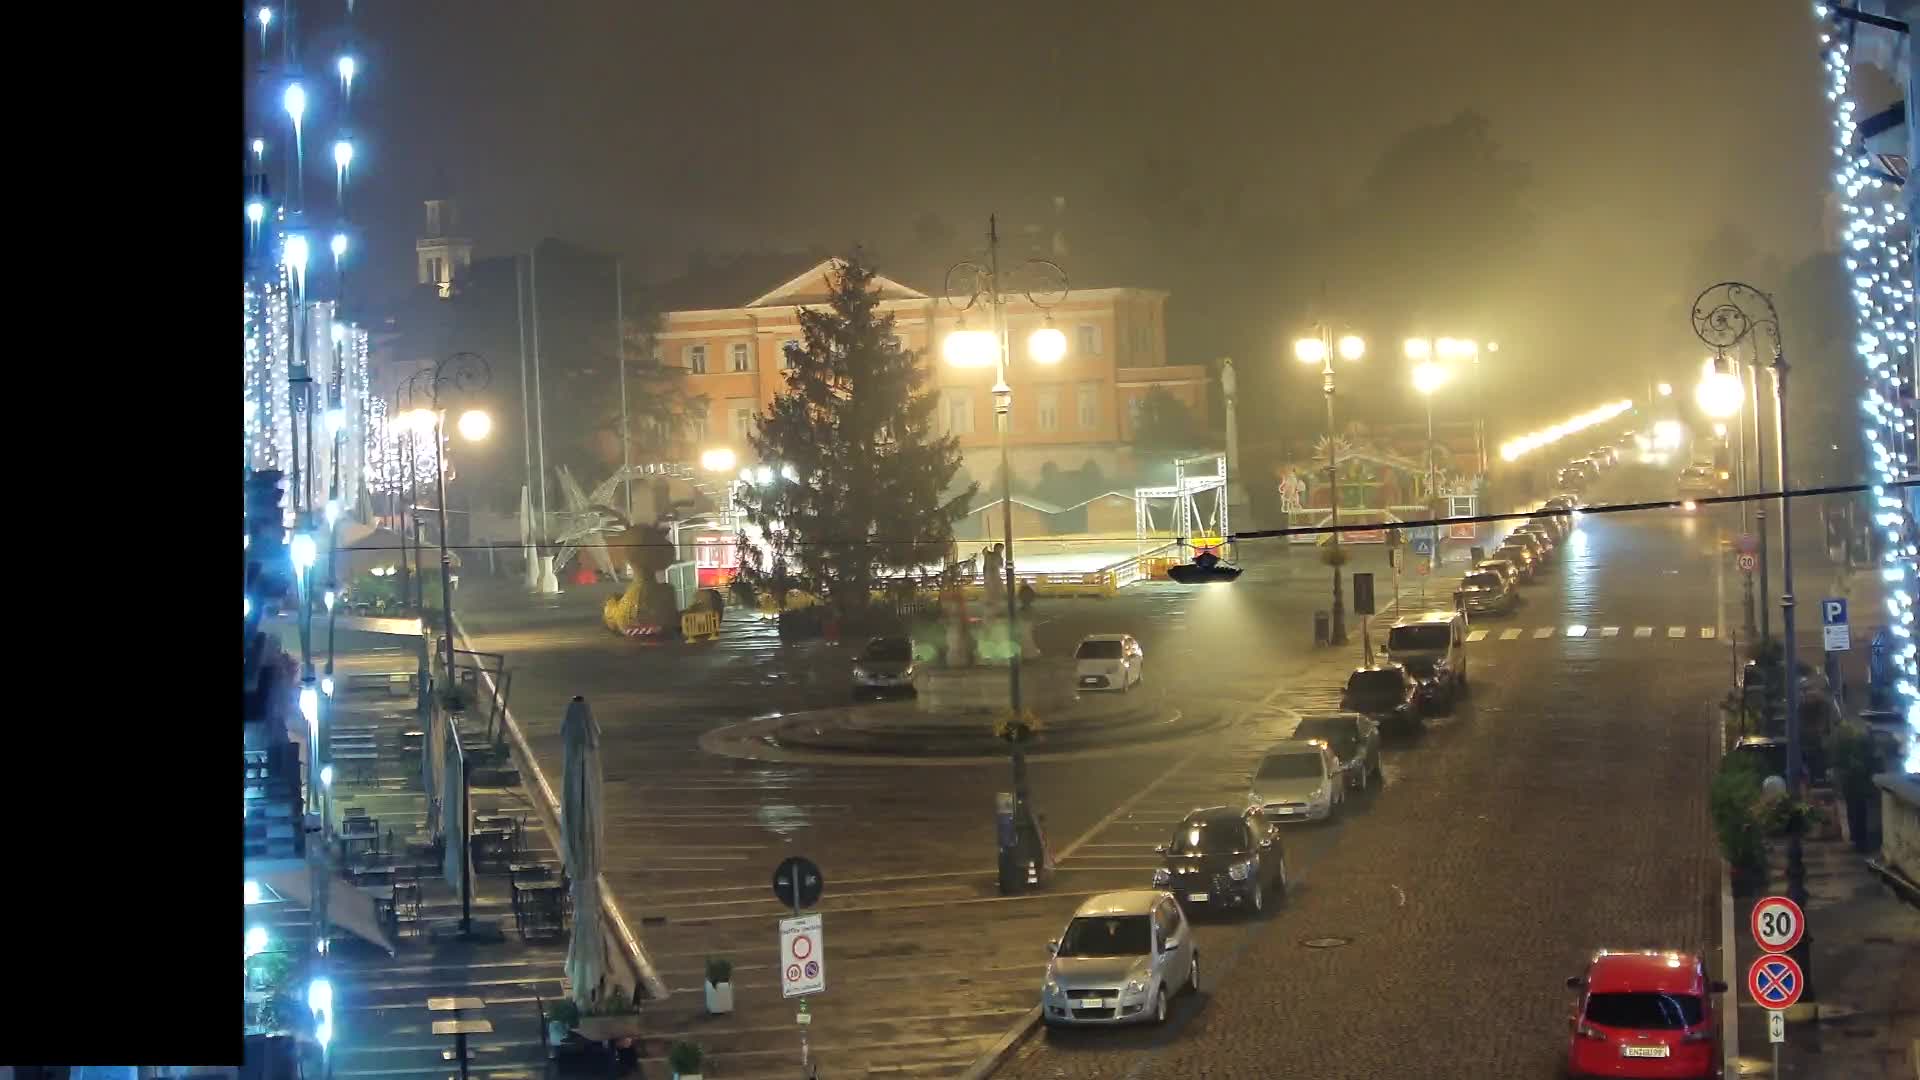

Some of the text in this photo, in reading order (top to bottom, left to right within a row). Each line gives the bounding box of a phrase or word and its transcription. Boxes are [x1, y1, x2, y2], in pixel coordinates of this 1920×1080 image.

[1742, 557, 1753, 567] 20
[1827, 601, 1842, 624] P
[1762, 911, 1792, 938] 30
